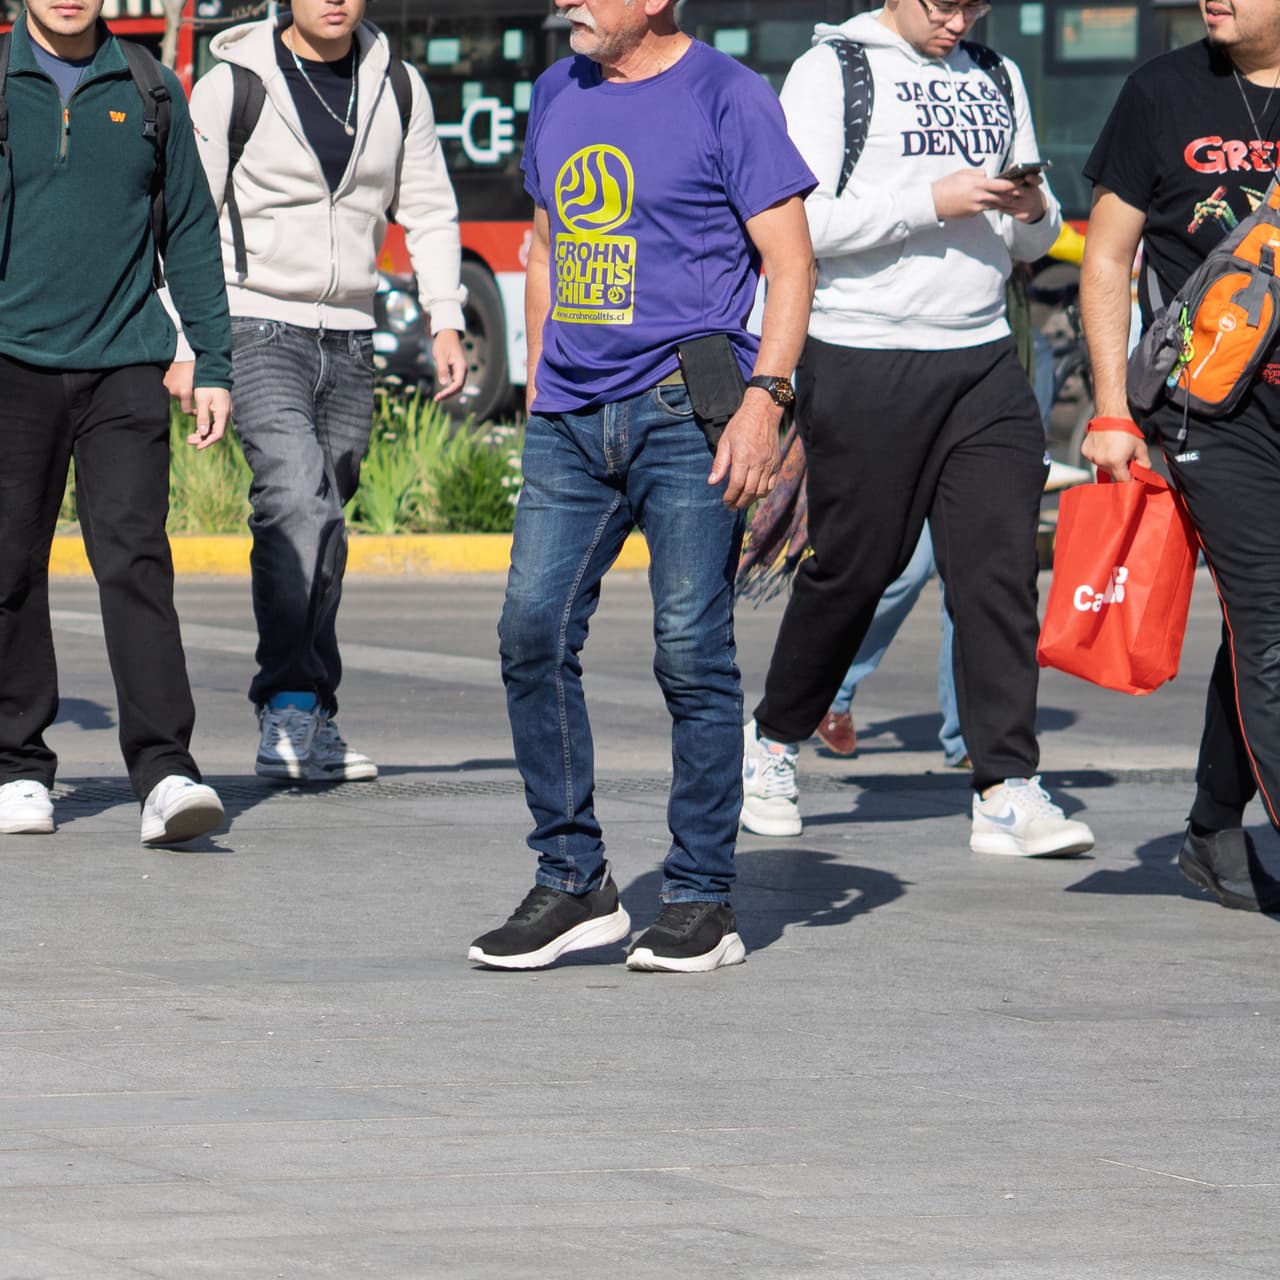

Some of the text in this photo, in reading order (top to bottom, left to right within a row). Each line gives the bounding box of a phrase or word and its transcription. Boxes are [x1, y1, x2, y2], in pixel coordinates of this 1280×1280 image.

[895, 79, 981, 103] JACK
[915, 103, 1011, 129] JONES
[900, 128, 1005, 167] DENIM
[557, 240, 630, 265] CROHN
[557, 259, 631, 285] COLITIS
[557, 281, 605, 305] CHILE
